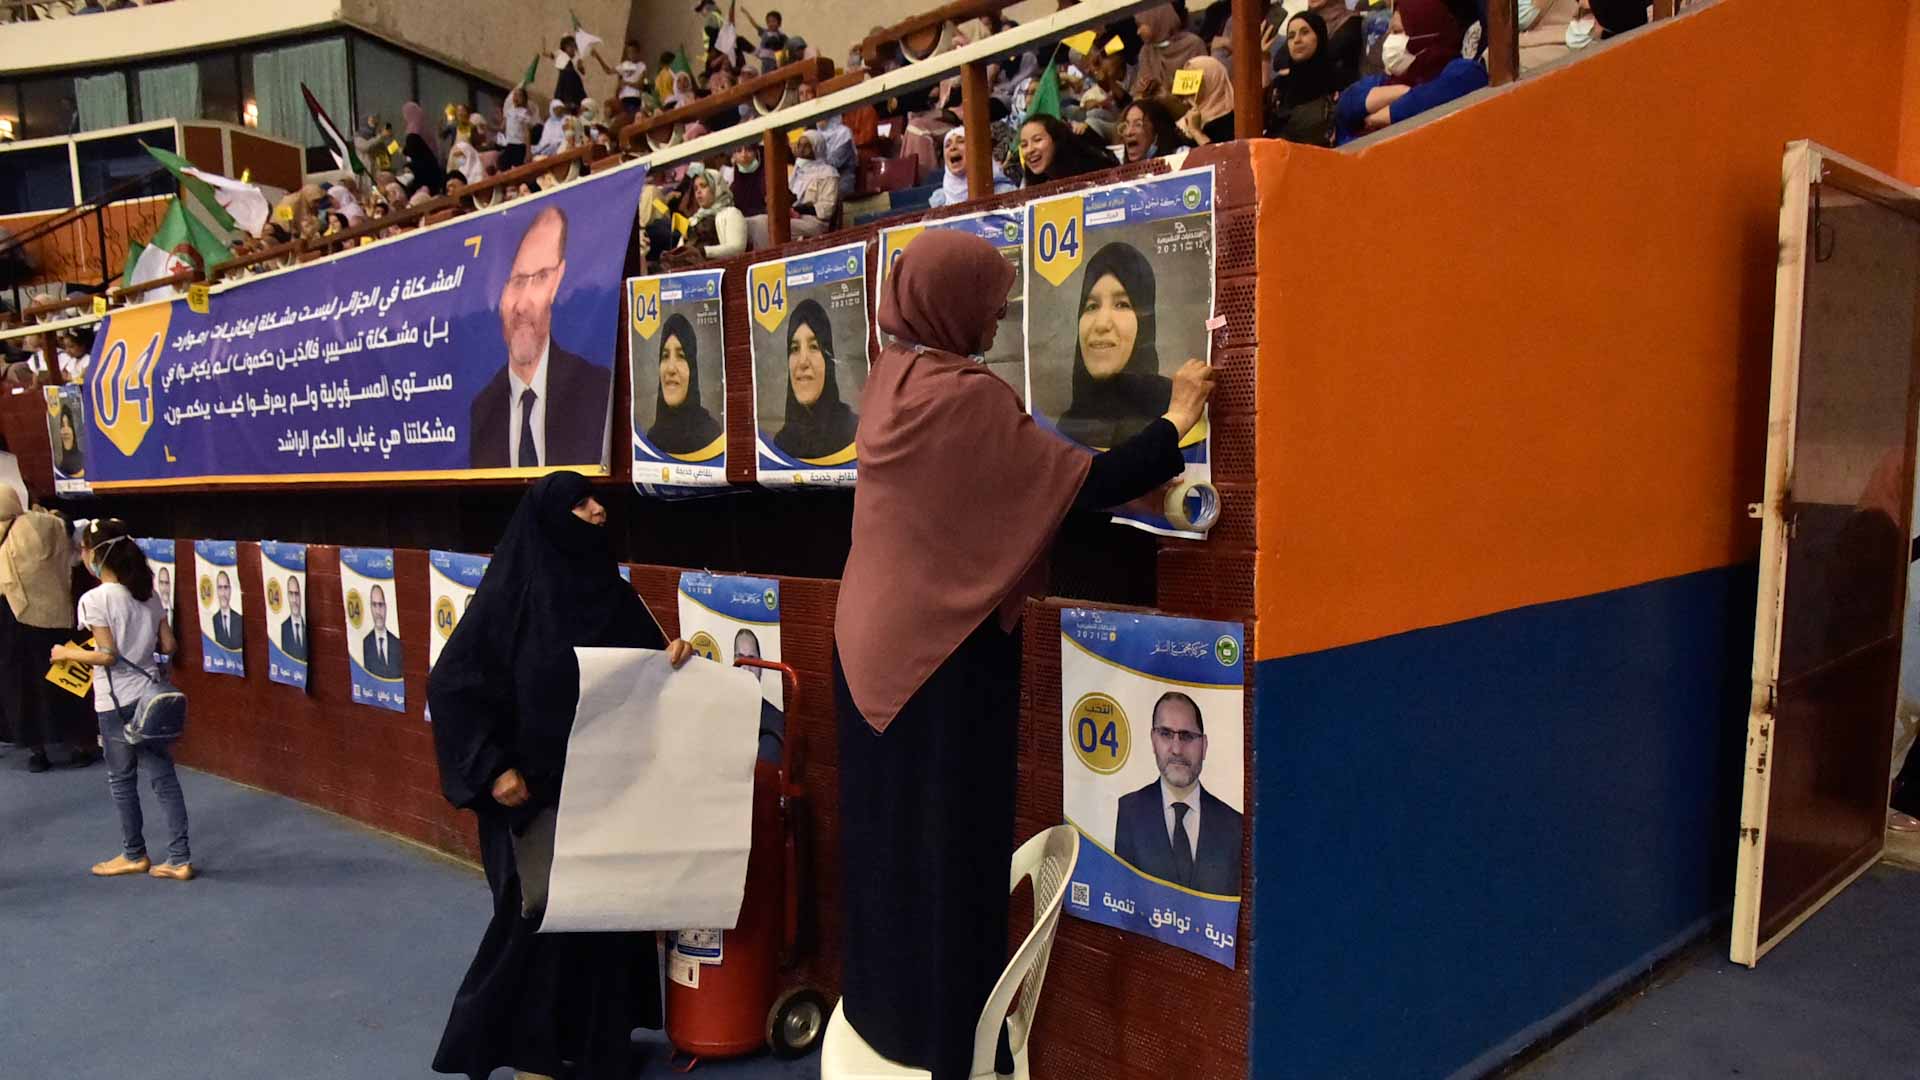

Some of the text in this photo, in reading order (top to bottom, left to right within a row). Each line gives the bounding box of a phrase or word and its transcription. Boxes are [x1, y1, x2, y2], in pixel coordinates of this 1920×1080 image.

[1039, 217, 1079, 262] 04
[401, 264, 465, 300] المشكلة
[757, 279, 784, 314] 04
[299, 295, 338, 321] ليست
[333, 286, 381, 320] الجزائر
[378, 279, 400, 317] في
[636, 293, 658, 322] 04
[257, 306, 297, 332] مشكلة
[424, 316, 449, 348] بل
[365, 320, 419, 350] مشكلة
[211, 354, 233, 377] لم
[233, 349, 275, 376] حكمونا
[276, 337, 320, 371] فالذين
[92, 332, 160, 428] 04
[161, 363, 177, 392] في
[320, 374, 390, 408] المسؤولية
[392, 371, 453, 402] مستوى
[213, 393, 245, 418] كيف
[246, 388, 287, 418] يعرفوا
[290, 384, 319, 415] ولم
[277, 416, 456, 459] مشكلتنا هي غياب الحكم الراشد
[438, 609, 453, 630] 04
[1078, 717, 1119, 758] 04
[1103, 891, 1235, 949] حرية توافق تنمية
